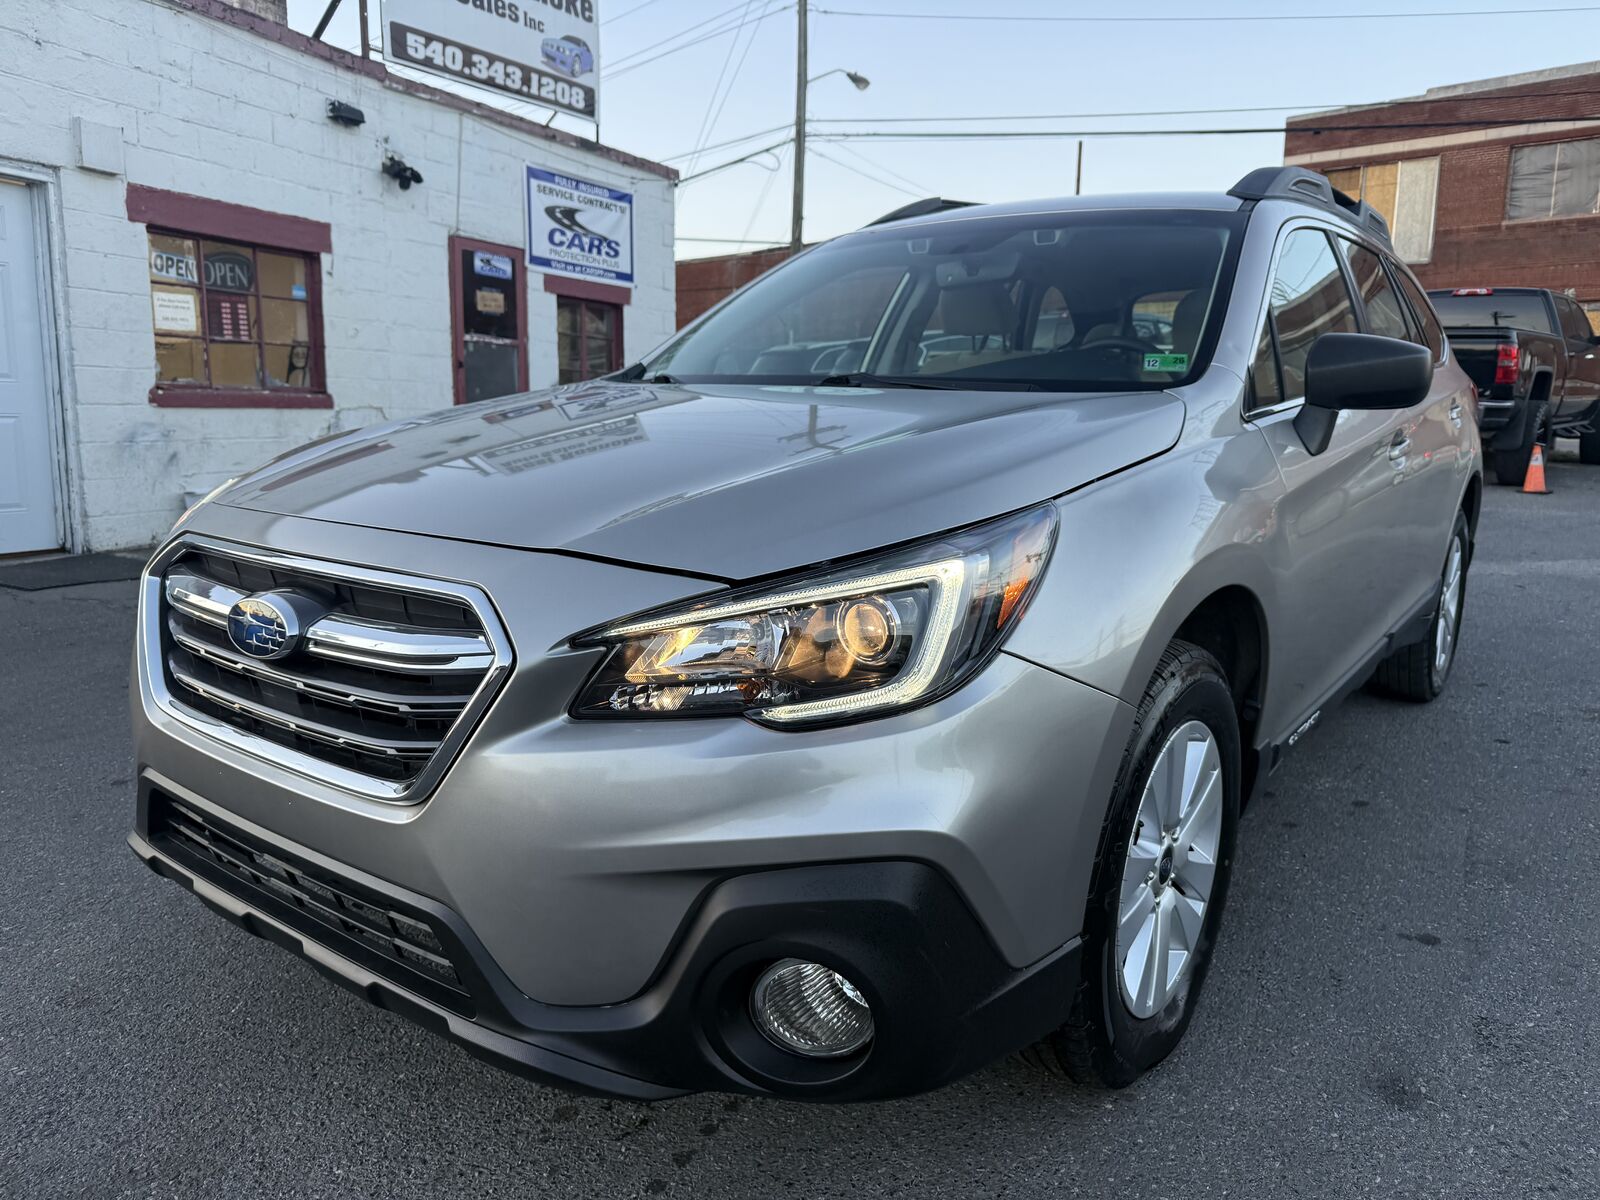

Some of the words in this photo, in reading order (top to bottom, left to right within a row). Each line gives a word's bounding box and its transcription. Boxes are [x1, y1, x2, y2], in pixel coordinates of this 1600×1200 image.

[456, 0, 519, 24] ales
[524, 11, 545, 33] Inc
[405, 31, 586, 110] 540.343.1208
[536, 184, 575, 202] SERVICE
[554, 175, 577, 190] FULLY
[578, 182, 609, 198] INSURED
[548, 228, 621, 259] CARS
[153, 254, 196, 280] OPEN
[549, 247, 601, 265] PROTECTION
[602, 258, 620, 269] PLUS
[203, 260, 249, 287] OPEN
[1147, 359, 1159, 368] 12
